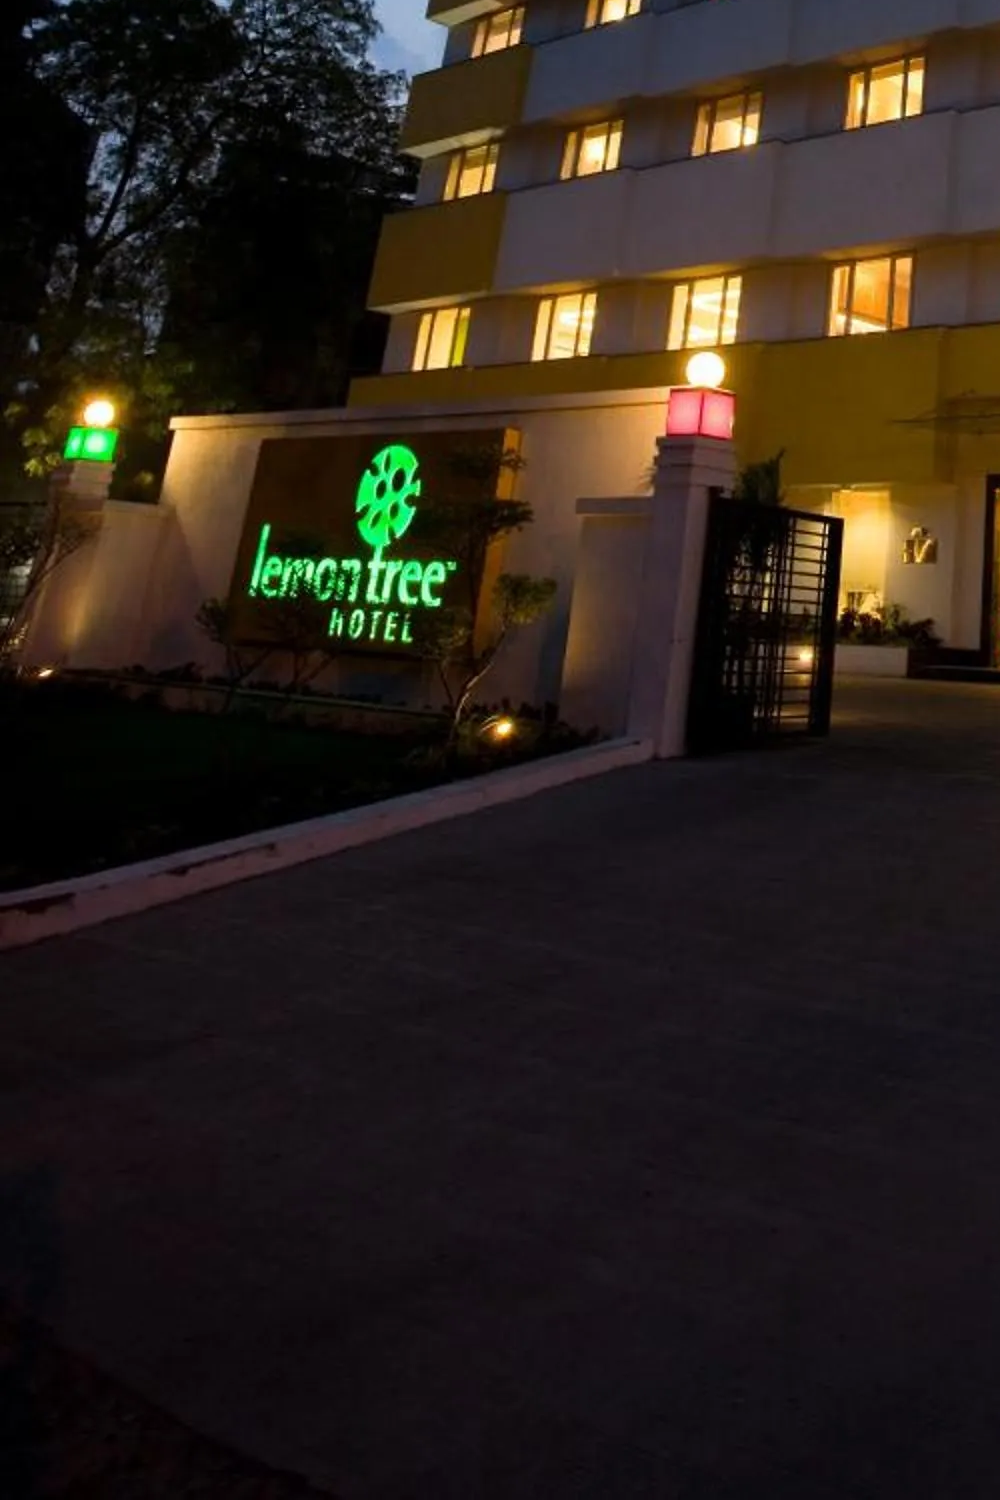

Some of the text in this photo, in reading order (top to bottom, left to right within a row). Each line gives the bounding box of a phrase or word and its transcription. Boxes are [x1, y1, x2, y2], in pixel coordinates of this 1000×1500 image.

[248, 523, 446, 607] lemon tree
[328, 608, 413, 643] HOTEL
